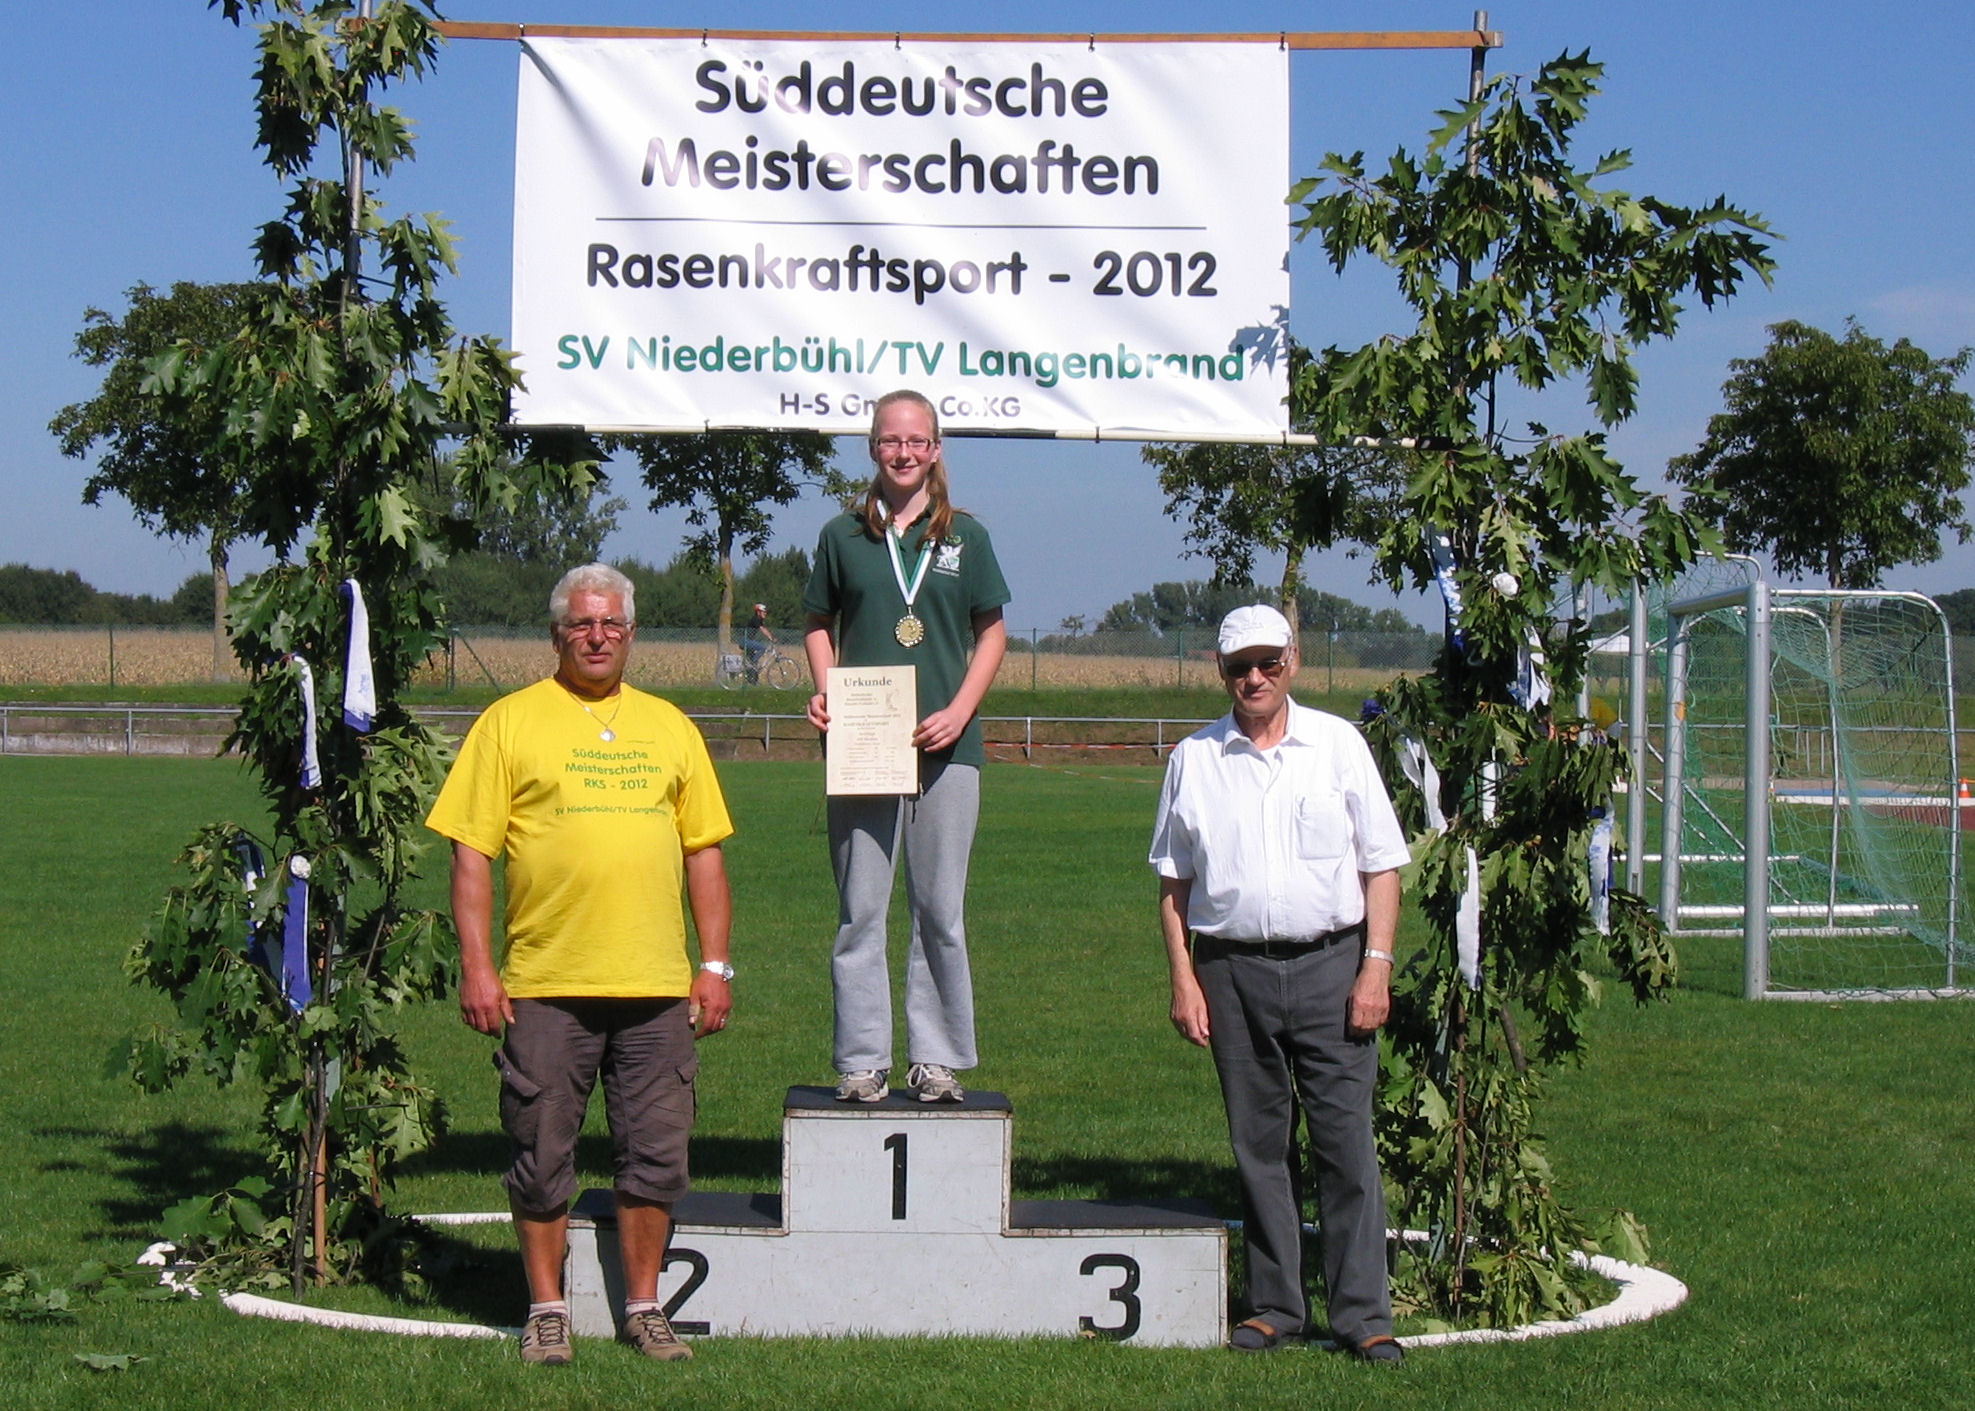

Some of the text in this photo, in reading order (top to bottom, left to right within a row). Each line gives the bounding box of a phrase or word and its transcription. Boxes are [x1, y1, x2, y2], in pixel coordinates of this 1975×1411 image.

[695, 60, 1108, 118] Süddeutsche
[641, 135, 1159, 196] Meisterschaften
[587, 242, 1217, 305] Rasenkraftsport - 2012
[557, 335, 1244, 388] SV Niederbühl/TV Langenbrand
[779, 393, 830, 416] H-S
[840, 394, 879, 416] Gm
[843, 676, 893, 688] Urkunde
[565, 762, 662, 775] Meisterschaften
[572, 748, 648, 760] Süddeutsche
[584, 778, 606, 790] RKS
[619, 778, 648, 791] 2012
[884, 1132, 907, 1220] 1
[659, 1247, 711, 1335] 2
[1078, 1253, 1141, 1342] 3
